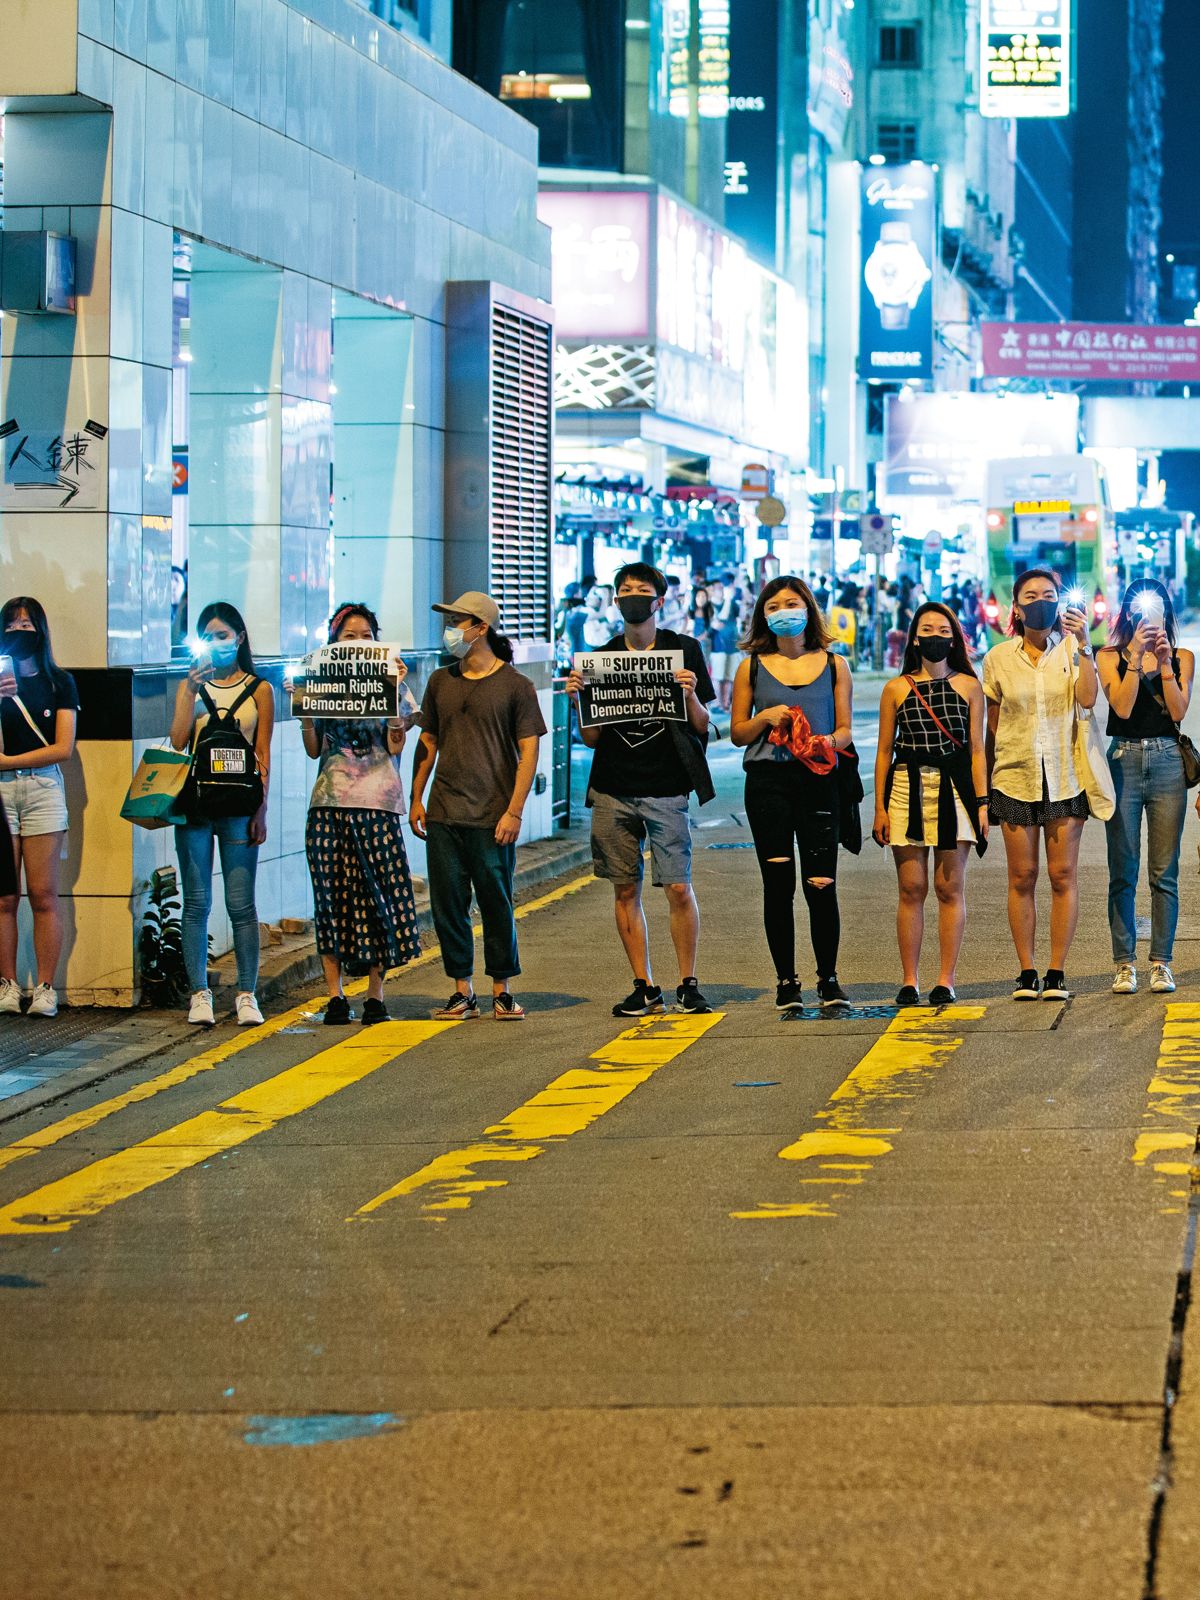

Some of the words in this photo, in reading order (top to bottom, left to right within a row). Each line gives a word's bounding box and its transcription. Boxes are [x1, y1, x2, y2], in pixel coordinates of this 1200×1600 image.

[1154, 335, 1198, 350] 有限公司
[1026, 349, 1051, 359] CHINA
[1052, 350, 1080, 360] TRAVEL
[1081, 350, 1114, 361] SERVICE
[1166, 352, 1197, 363] LIMITED
[330, 646, 390, 661] SUPPORT
[305, 668, 316, 676] the
[320, 662, 354, 676] HONG
[356, 662, 389, 676] KONG
[582, 659, 594, 669] US
[602, 658, 611, 667] TO
[613, 656, 673, 671] SUPPORT
[603, 673, 638, 684] HONG
[640, 672, 674, 684] KONG
[305, 679, 346, 694] Human
[349, 678, 384, 697] Rights
[591, 686, 633, 701] Human
[635, 685, 672, 701] Rights
[302, 696, 367, 715] Democracy
[369, 696, 388, 711] Act
[590, 702, 655, 719] Democracy
[657, 699, 677, 714] Act
[213, 750, 243, 760] TOGETHER
